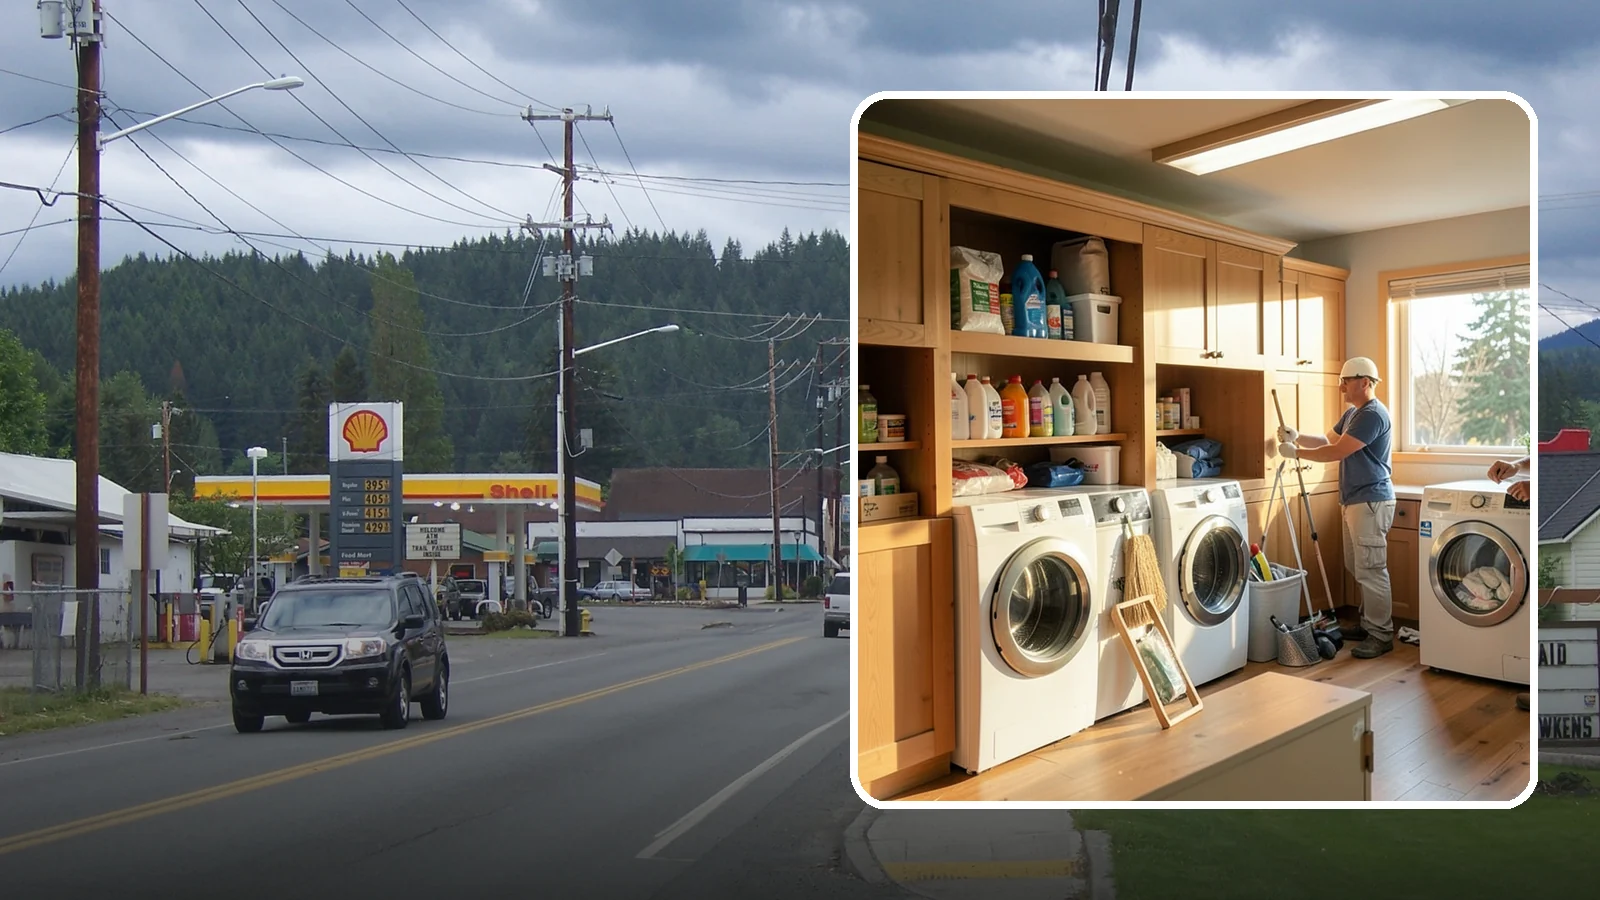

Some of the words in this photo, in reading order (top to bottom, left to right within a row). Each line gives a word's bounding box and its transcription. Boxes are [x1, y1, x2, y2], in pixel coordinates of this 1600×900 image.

[365, 480, 384, 491] 395
[490, 484, 547, 499] Shell
[365, 494, 384, 504] 405
[365, 507, 384, 518] 415
[365, 522, 384, 533] 429
